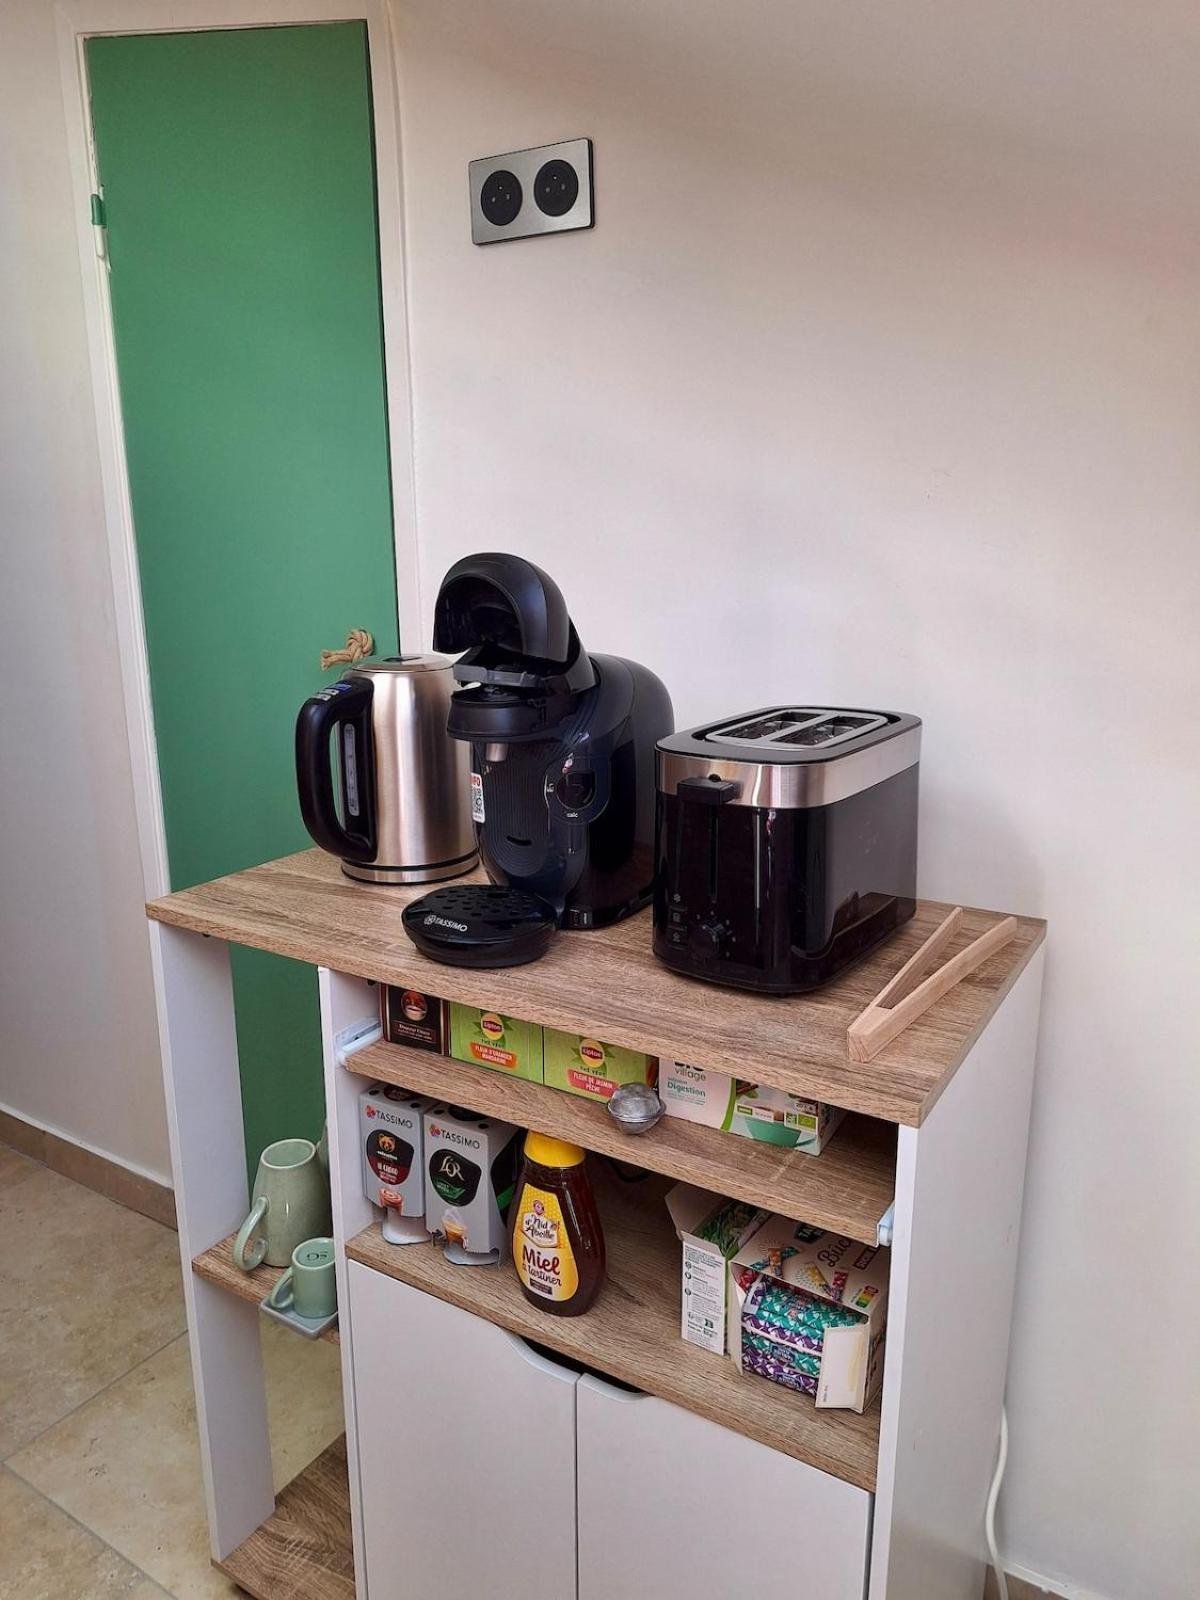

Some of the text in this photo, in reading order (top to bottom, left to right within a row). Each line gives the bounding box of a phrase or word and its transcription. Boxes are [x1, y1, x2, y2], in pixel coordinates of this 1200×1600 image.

[435, 916, 468, 932] TASSIMO
[483, 1020, 502, 1031] Lipton
[581, 1046, 603, 1059] Lipton
[674, 1066, 706, 1081] village
[667, 1081, 706, 1097] Digestion
[376, 1110, 413, 1129] TASSIMO
[440, 1131, 481, 1150] TASSIMO
[522, 1244, 561, 1275] Miel
[528, 1264, 562, 1287] tartiner
